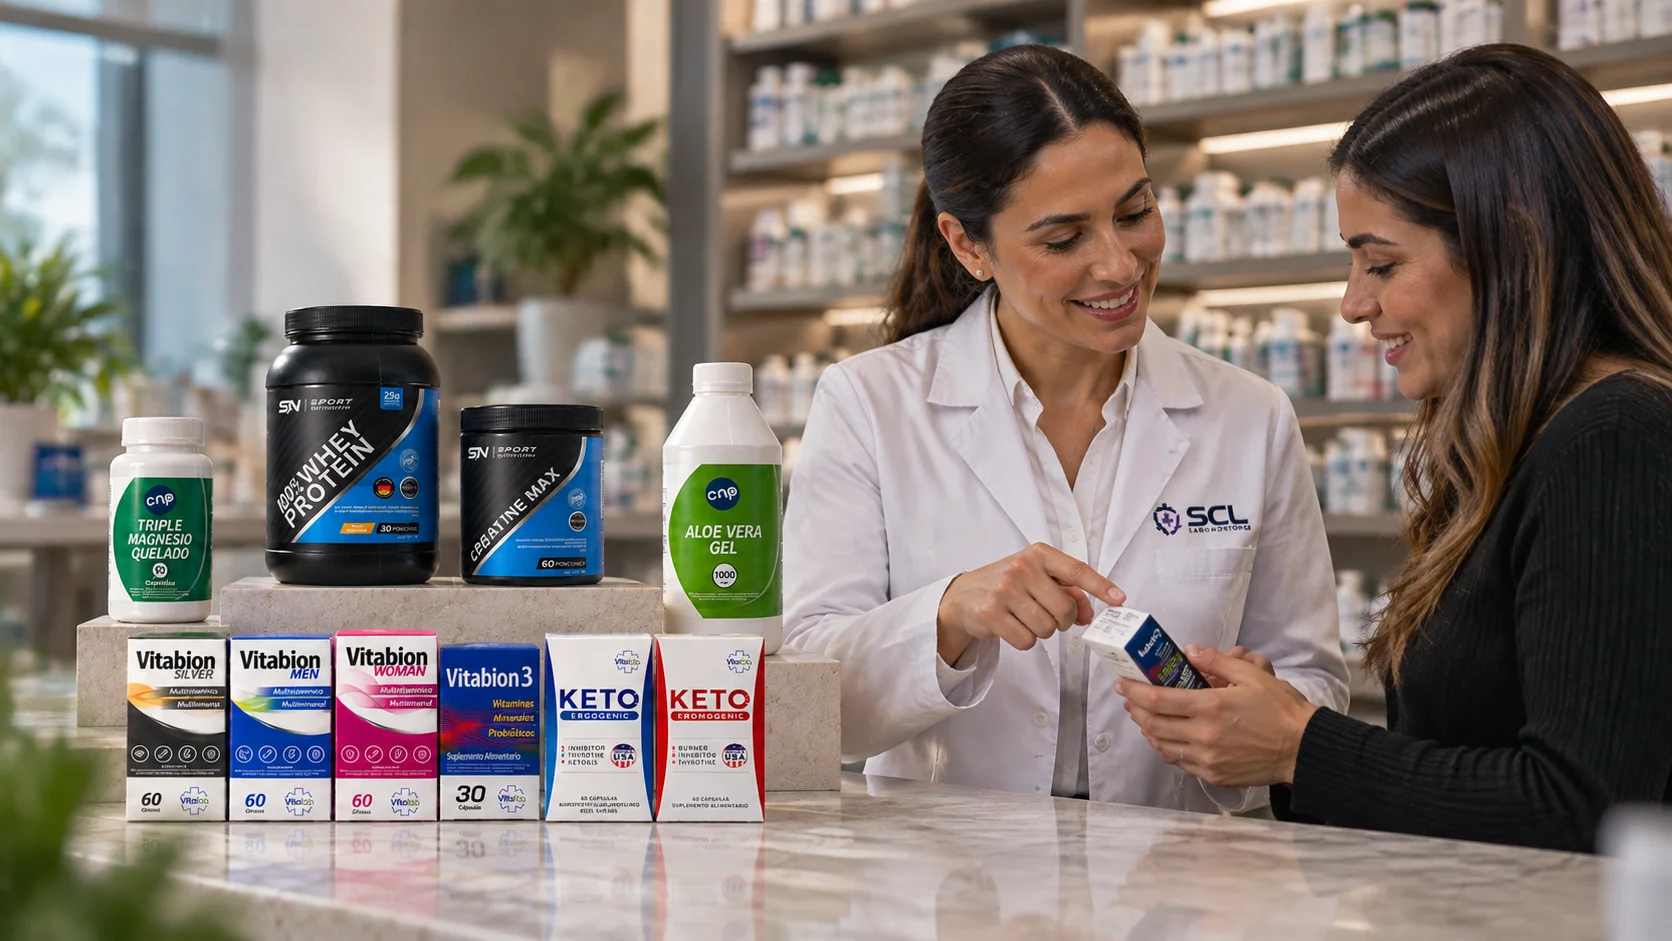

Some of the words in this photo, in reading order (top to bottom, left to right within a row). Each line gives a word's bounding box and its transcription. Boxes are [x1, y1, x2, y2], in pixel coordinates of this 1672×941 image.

[279, 400, 301, 414] SN
[297, 419, 361, 484] WHEY
[468, 446, 489, 460] SN
[284, 436, 375, 529] PROTEIN
[524, 467, 560, 502] MAX
[146, 493, 175, 507] cnp
[707, 486, 738, 501] cnp
[1186, 504, 1249, 527] SCL
[137, 519, 183, 531] TRIPLE
[380, 524, 392, 533] 30
[685, 524, 722, 539] ALOE
[726, 524, 763, 539] VERA
[128, 533, 192, 546] MAGNESIO
[131, 547, 189, 560] QUELADO
[709, 541, 738, 555] GEL
[541, 560, 555, 568] 60
[714, 570, 736, 579] 1000
[136, 650, 216, 670] Vitabion
[240, 650, 321, 670] Vitabion
[346, 646, 428, 666] Vitabion
[174, 669, 215, 679] SILVER
[289, 669, 320, 679] MEN
[373, 665, 427, 677] WOMAN
[446, 665, 519, 688] Vitabion
[521, 665, 533, 688] 3
[559, 688, 640, 710] KETO
[670, 689, 751, 710] KETO
[571, 712, 629, 720] ERGOGENIC
[613, 753, 634, 761] USA
[724, 753, 746, 761] USA
[141, 792, 162, 807] 60
[245, 793, 266, 807] 60
[352, 793, 373, 808] 60
[455, 784, 486, 803] 30
